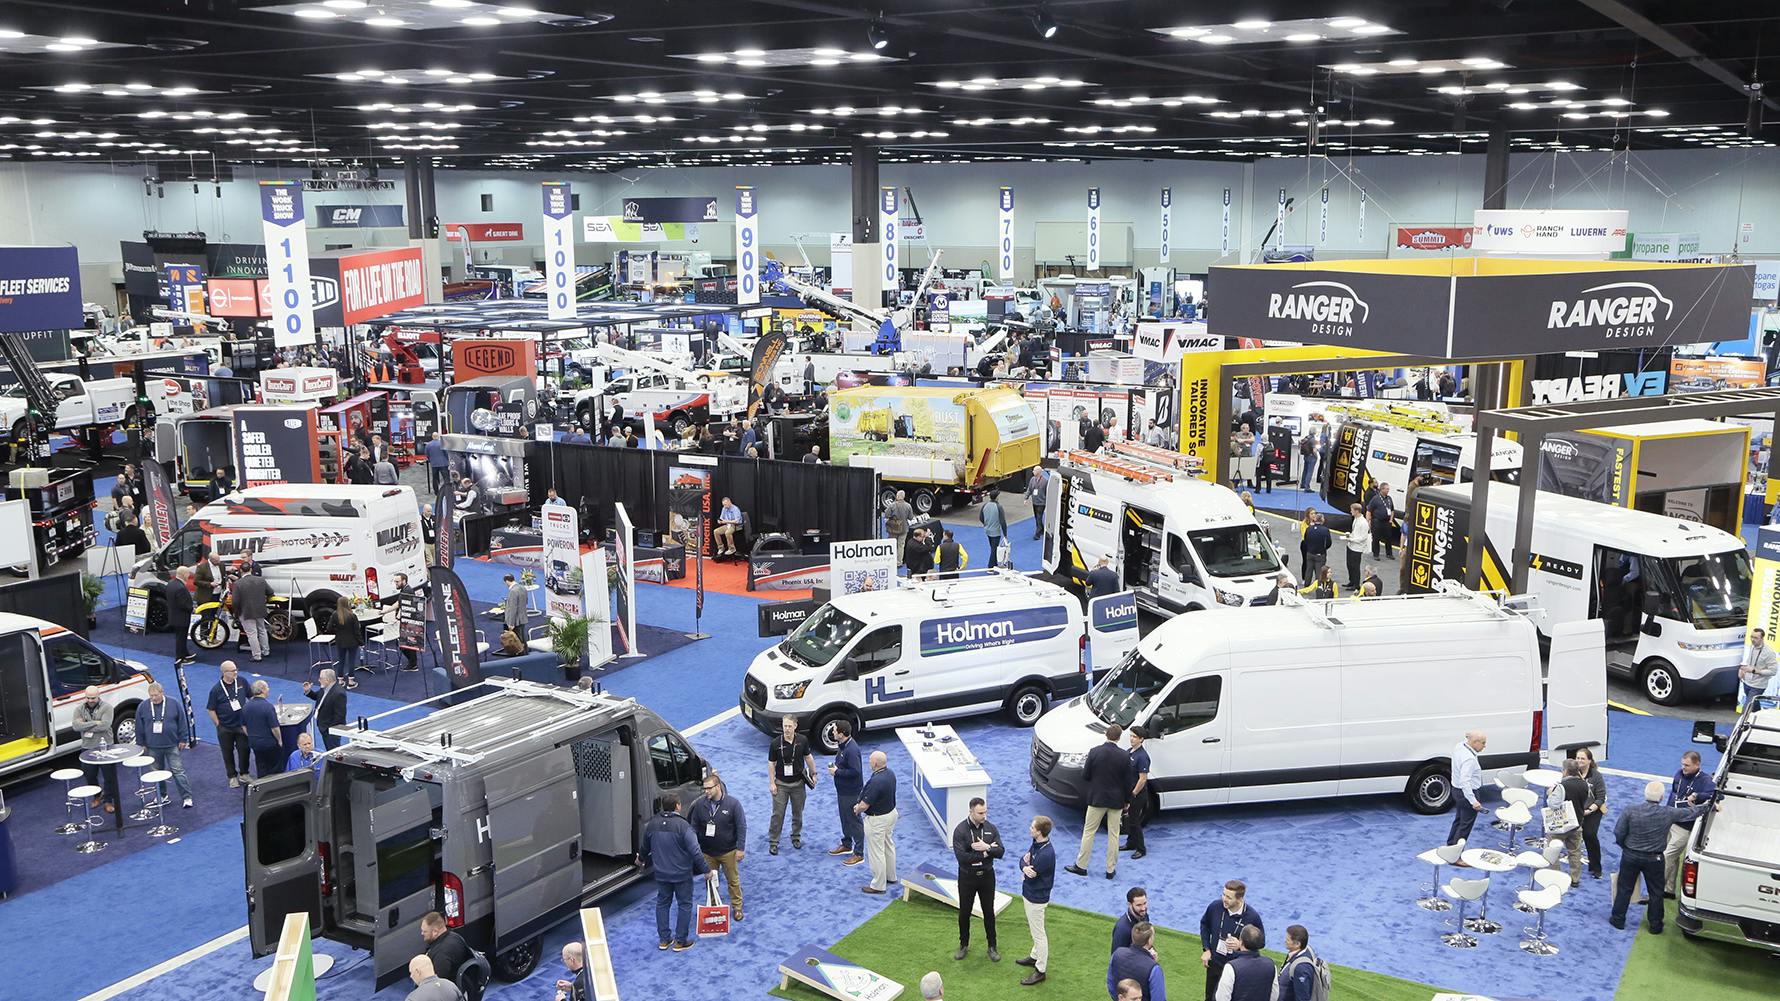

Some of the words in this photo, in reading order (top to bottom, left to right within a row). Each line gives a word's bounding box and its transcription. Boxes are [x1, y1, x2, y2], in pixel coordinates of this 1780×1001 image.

[272, 204, 293, 212] TRUCK
[274, 212, 294, 220] SHOW
[332, 208, 362, 220] CM
[1494, 227, 1513, 236] UWS
[1570, 228, 1607, 237] LUVERNE
[235, 256, 267, 264] DRIVIN
[742, 228, 754, 294] 900
[886, 222, 894, 281] 800
[226, 266, 269, 275] INNOVAT
[554, 229, 568, 309] 1000
[1754, 272, 1776, 282] opane
[0, 280, 26, 296] FLEET
[27, 276, 70, 294] SERVICES
[280, 238, 302, 334] 1100
[311, 280, 334, 303] END
[344, 268, 360, 312] FOR
[368, 265, 382, 307] LIFE
[382, 263, 391, 304] ON
[392, 261, 405, 300] THE
[405, 259, 421, 297] ROAD
[1754, 282, 1776, 290] togas
[1268, 293, 1355, 324] RANGER
[1547, 296, 1658, 329] RANGER
[23, 330, 54, 340] UPFIT
[1312, 324, 1353, 336] DESIGN
[1606, 326, 1654, 338] DESIGN
[1140, 336, 1160, 348] VMAC
[1178, 338, 1219, 348] VMAC
[468, 346, 512, 368] LEGEND
[1188, 380, 1199, 438] TAILORED
[1198, 378, 1208, 447] INNOVATIVE
[242, 432, 265, 444] SAFER
[1540, 440, 1573, 457] ANGER
[524, 462, 530, 476] WE
[1348, 428, 1366, 495] RANGER
[1612, 448, 1625, 500] FASTEST
[702, 492, 712, 514] USA,
[376, 522, 412, 547] VALLEY
[702, 518, 712, 556] Phoenix
[1447, 510, 1456, 550] DESIGN
[217, 536, 268, 556] VALLEY
[281, 533, 350, 548] MOTORSPORTS
[1430, 506, 1450, 594] RANGER
[834, 544, 894, 559] Holman
[1546, 561, 1580, 574] READY
[442, 583, 455, 613] ONE
[1768, 569, 1780, 642] INNOVATIVE
[772, 609, 806, 620] Holman
[1106, 604, 1137, 619] Holm
[447, 616, 462, 663] FLEET
[936, 620, 1014, 644] Holman
[965, 641, 983, 650] Driving
[984, 640, 1001, 648] What's
[1001, 638, 1015, 646] Right
